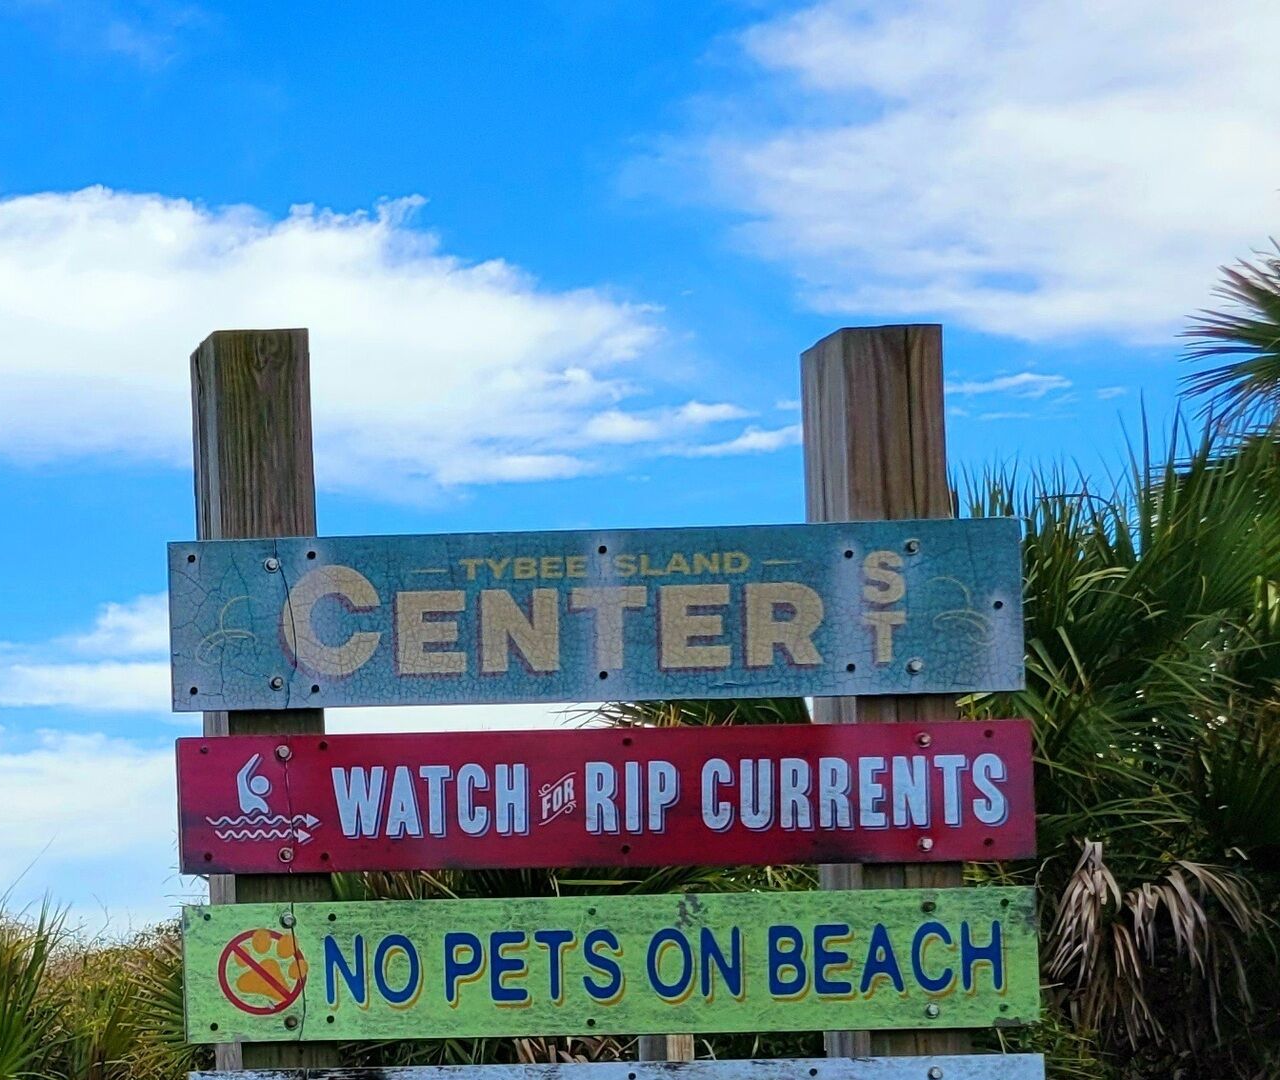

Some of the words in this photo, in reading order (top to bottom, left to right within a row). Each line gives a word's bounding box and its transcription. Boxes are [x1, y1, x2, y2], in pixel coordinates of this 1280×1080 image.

[459, 555, 588, 581] TYBEE
[597, 551, 751, 577] SLAND
[280, 564, 824, 678] CENTER
[331, 763, 529, 837] WATCH
[541, 777, 575, 820] FOR
[585, 761, 680, 835] RIP
[702, 752, 1010, 832] CURRENTS
[324, 932, 424, 1007] NO
[445, 929, 625, 1004] PETS
[646, 925, 746, 1001] ON
[769, 919, 1007, 999] BEACH
